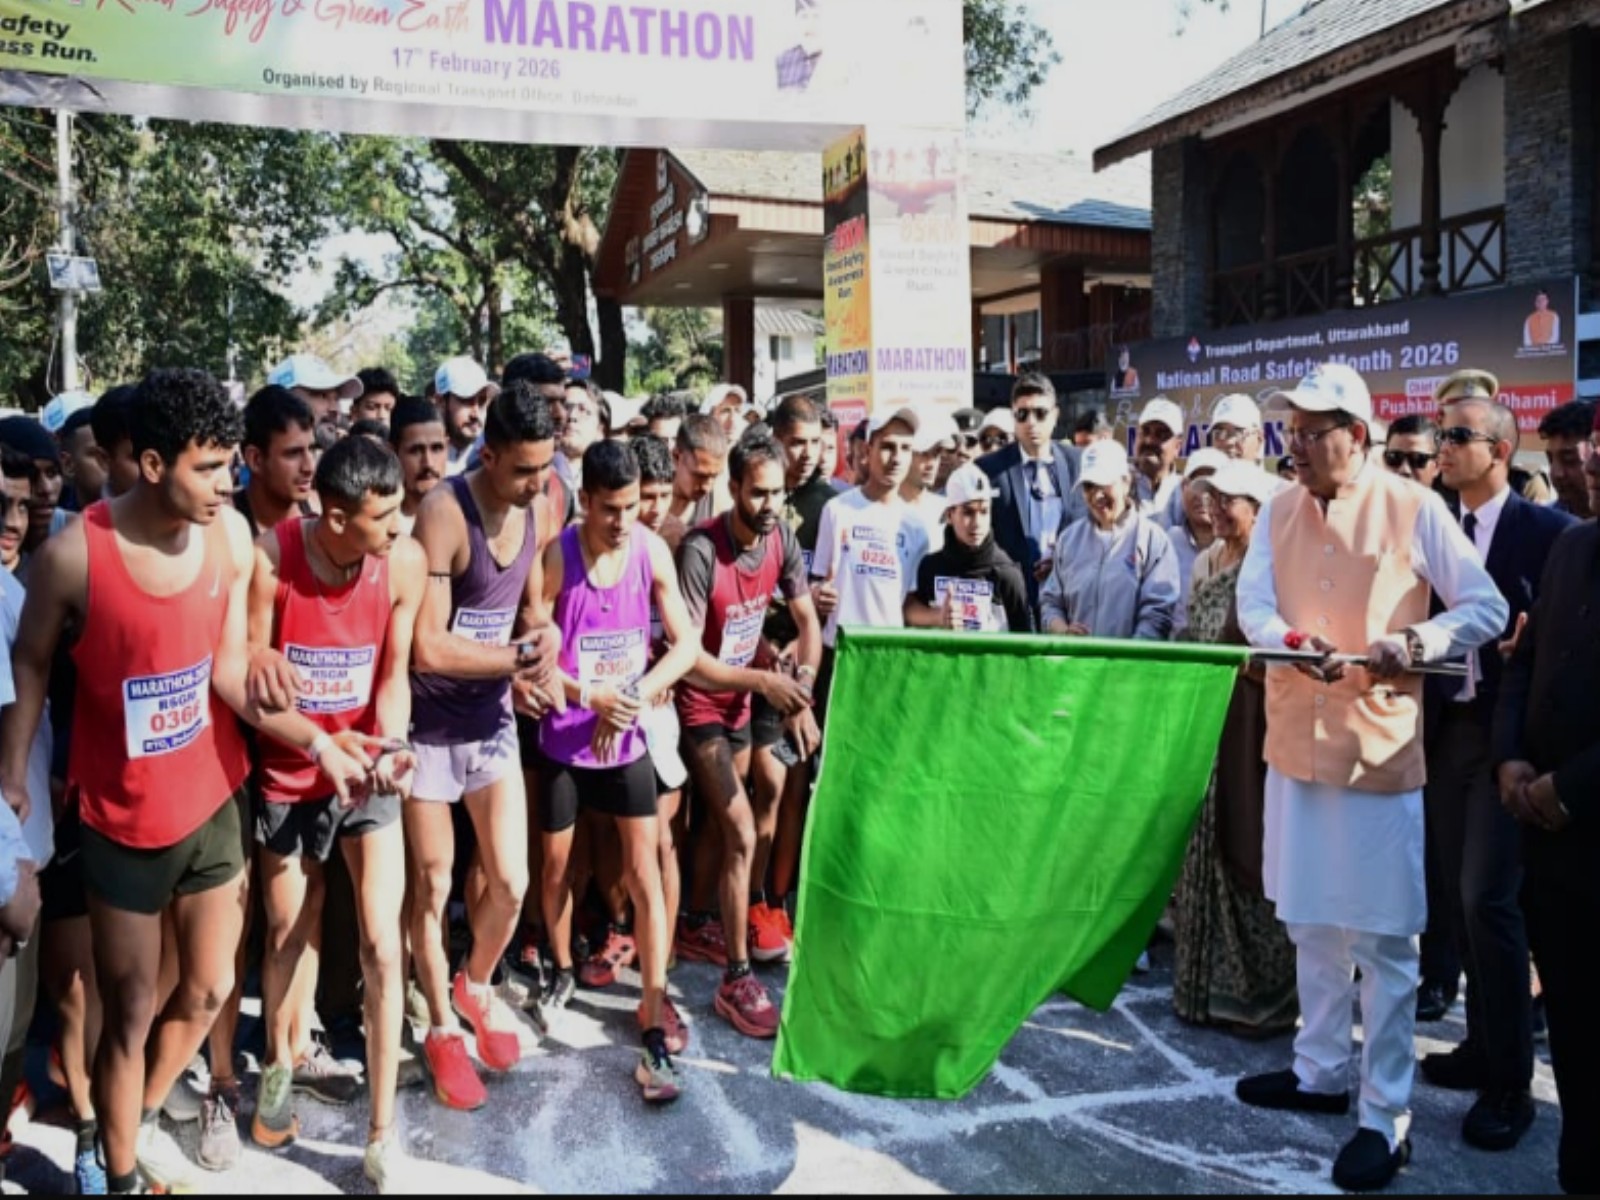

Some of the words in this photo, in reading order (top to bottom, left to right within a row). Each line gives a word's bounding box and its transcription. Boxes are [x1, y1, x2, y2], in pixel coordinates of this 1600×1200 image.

[483, 0, 754, 60] MARATHON
[41, 42, 97, 62] Run.
[429, 50, 511, 79] February
[516, 59, 562, 79] 2026
[263, 67, 345, 89] Organised
[350, 76, 368, 94] by
[373, 77, 440, 96] Regional
[447, 80, 515, 101] Transport
[1205, 341, 1252, 358] Transport
[1254, 331, 1324, 353] Department,
[1327, 319, 1410, 344] Uttarakhand
[826, 350, 869, 377] MARATHON
[877, 347, 966, 371] MARATHON
[1156, 367, 1216, 390] National
[1220, 362, 1261, 384] Road
[1399, 341, 1460, 369] 2026
